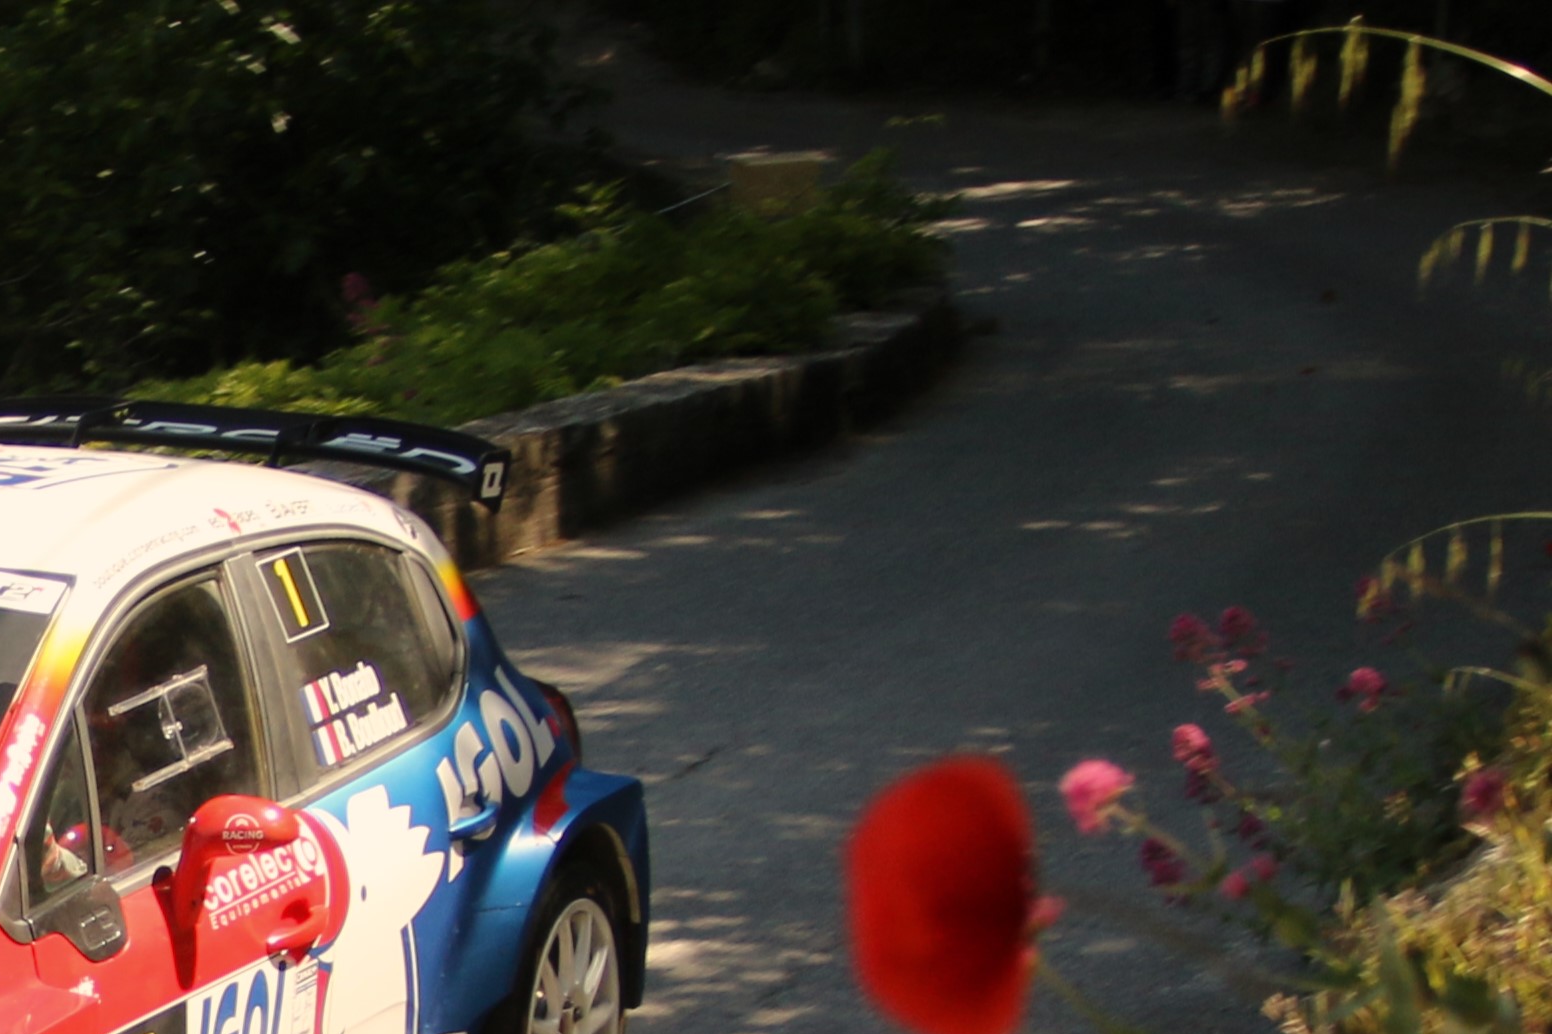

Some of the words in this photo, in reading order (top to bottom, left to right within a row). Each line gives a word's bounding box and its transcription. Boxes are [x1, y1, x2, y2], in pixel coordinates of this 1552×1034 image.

[274, 557, 309, 628] 1
[221, 829, 265, 841] RACING
[202, 845, 293, 911] corelec
